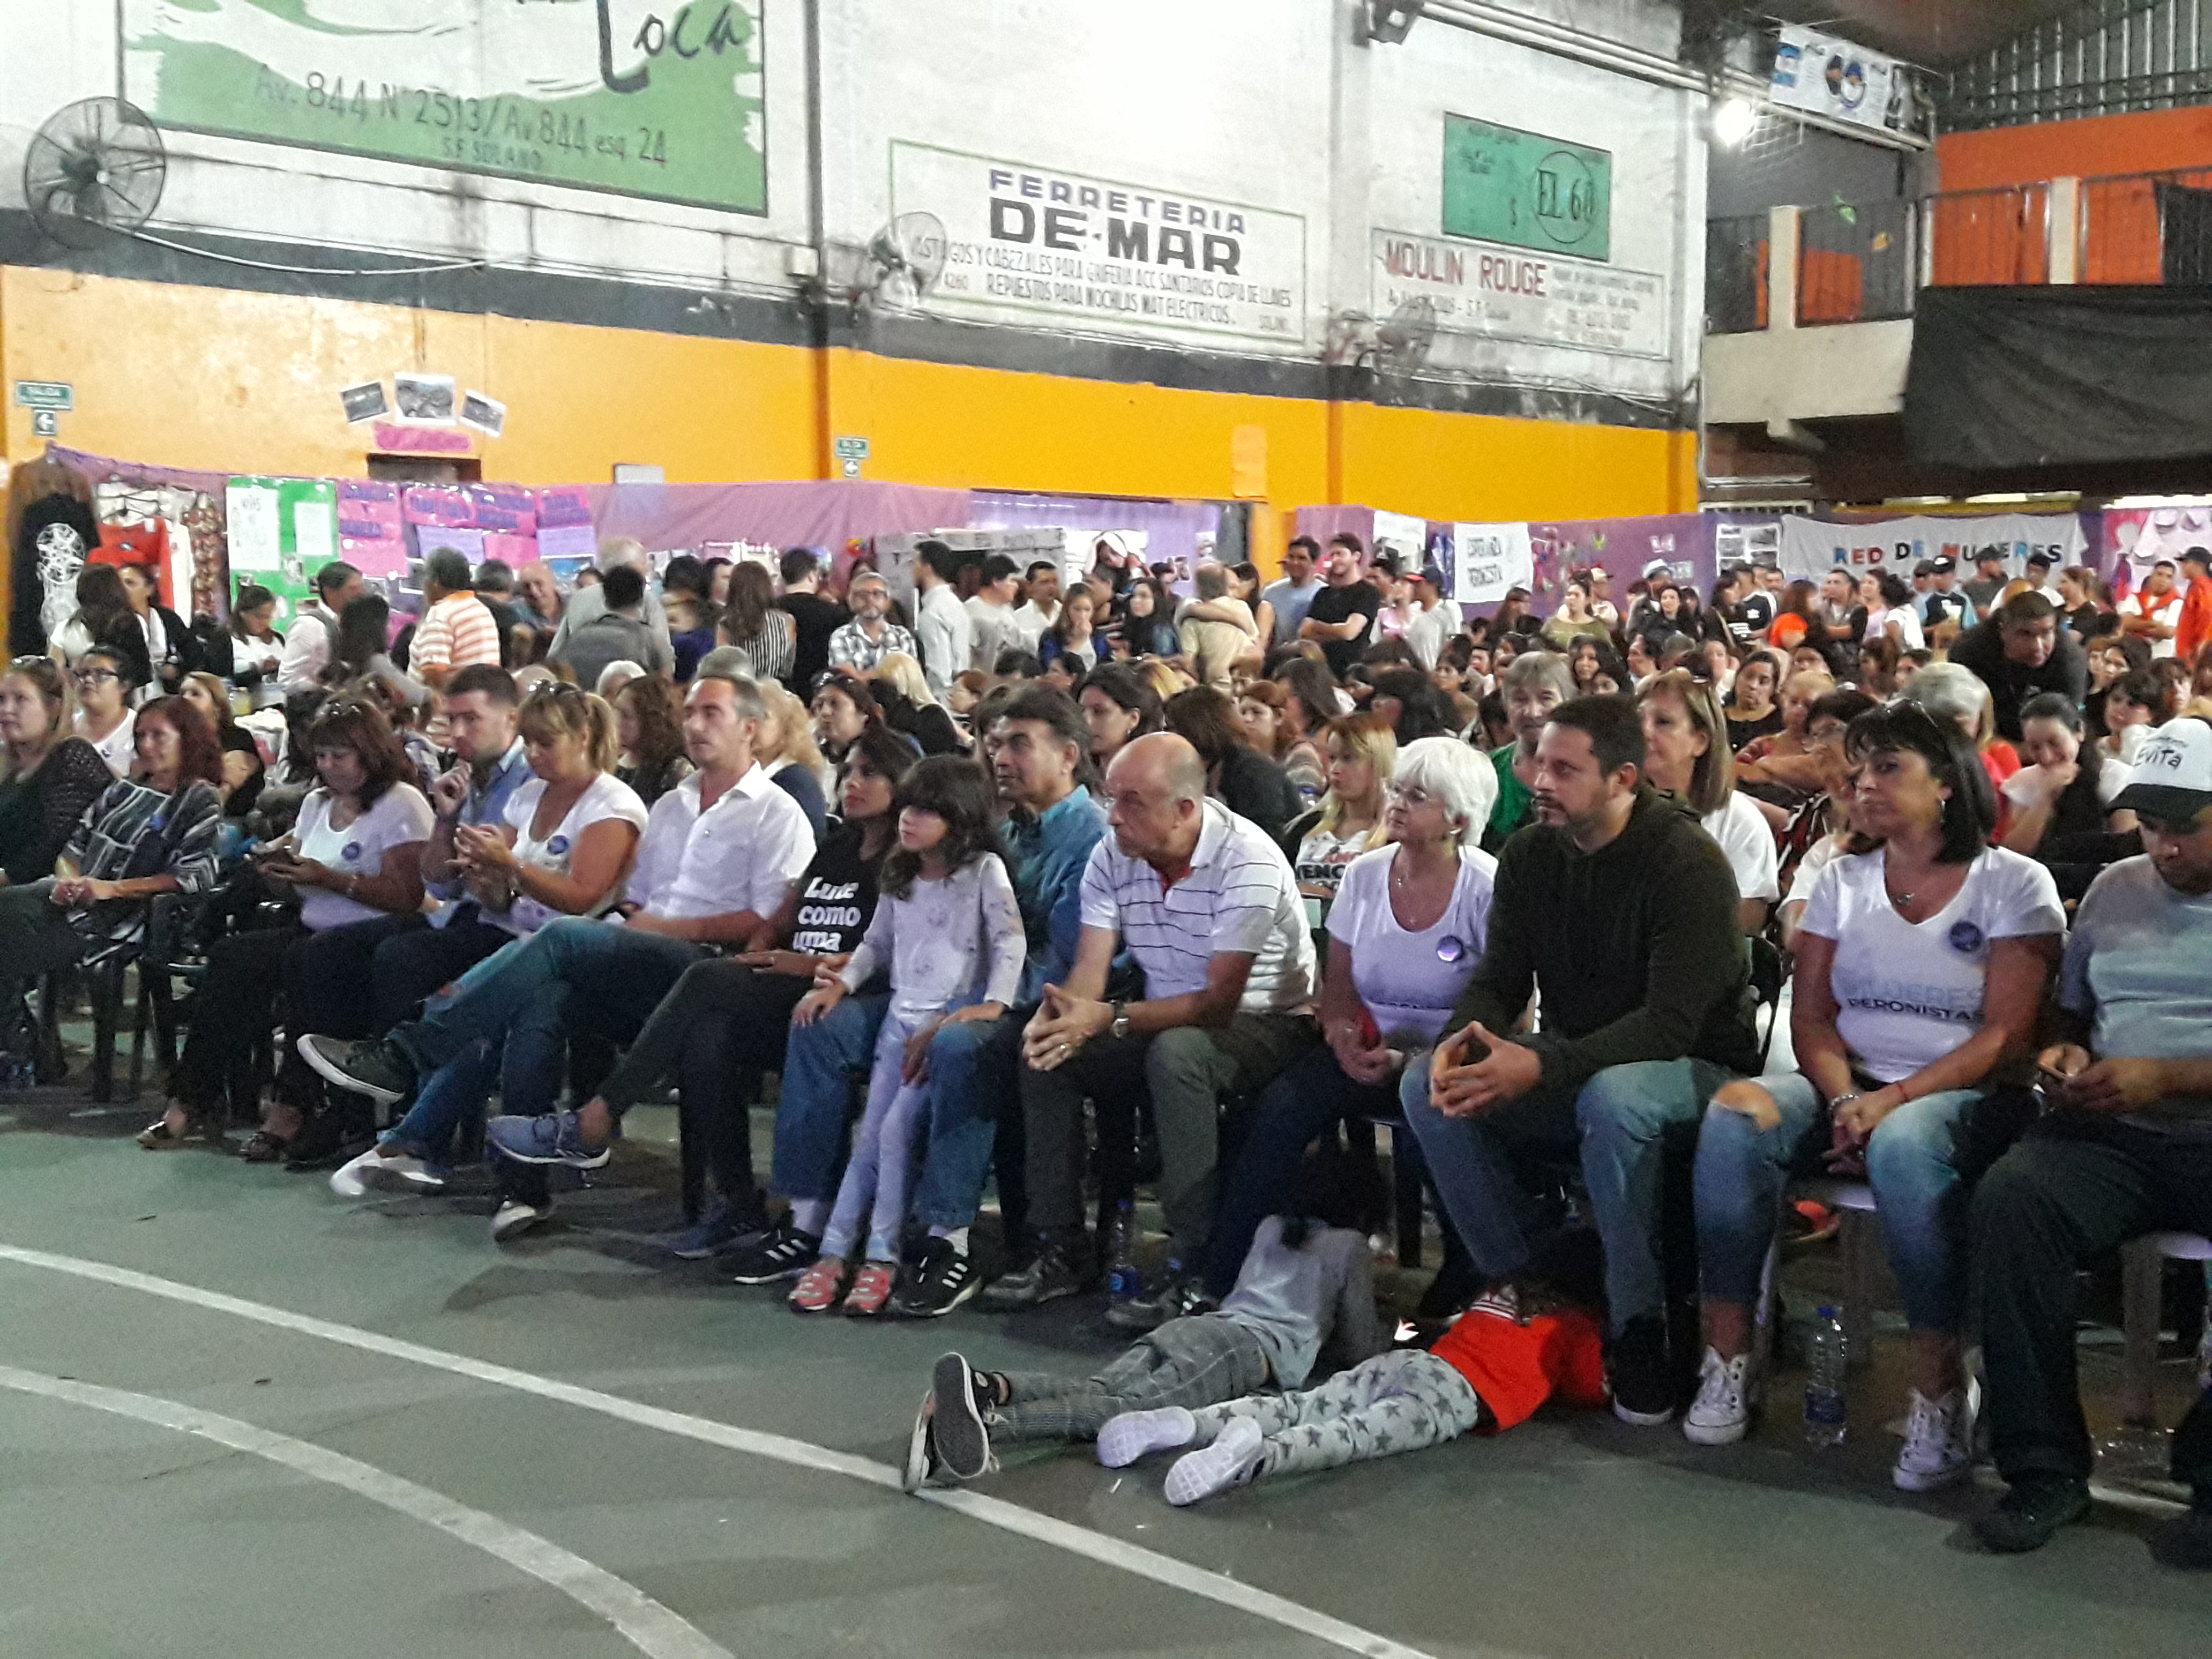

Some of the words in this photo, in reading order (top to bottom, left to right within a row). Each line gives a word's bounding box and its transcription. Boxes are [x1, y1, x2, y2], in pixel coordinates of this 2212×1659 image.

[307, 71, 368, 123] 844
[540, 109, 588, 159] 844
[989, 168, 1246, 235] FERRETERIA
[1386, 238, 1463, 286] MOULIN
[1480, 254, 1547, 297] ROUGE
[1833, 545, 1884, 565] RED
[1894, 539, 1926, 561] DE
[1941, 540, 2064, 564] MUERS
